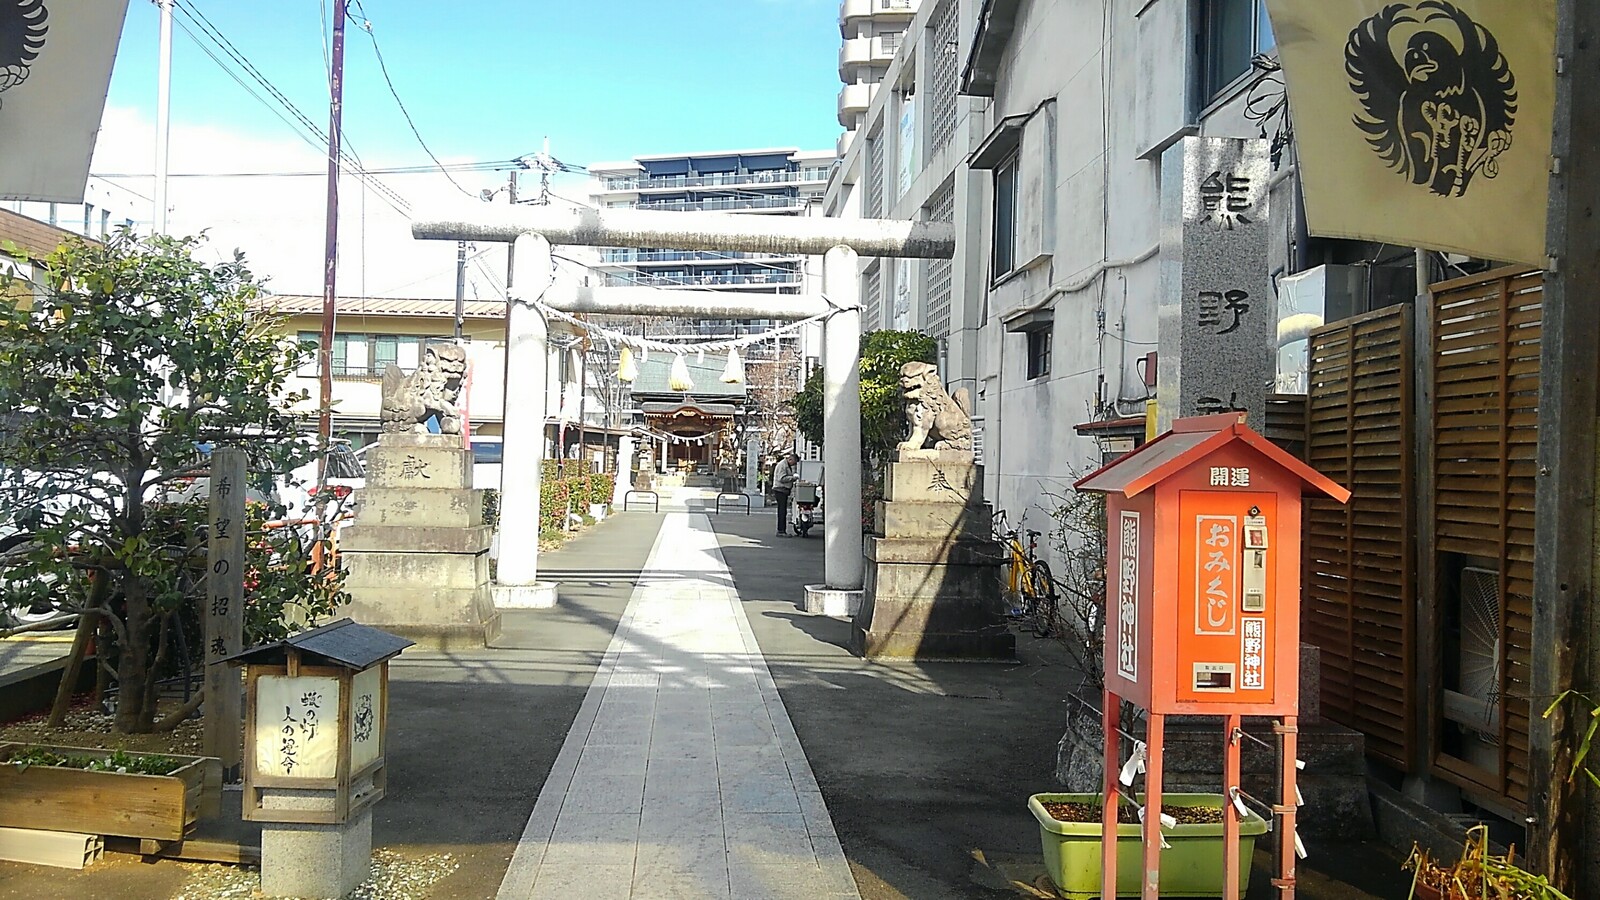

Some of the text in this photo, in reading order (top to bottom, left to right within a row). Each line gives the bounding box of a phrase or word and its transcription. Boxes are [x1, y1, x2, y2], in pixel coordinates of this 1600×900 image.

[927, 470, 953, 494] 奉
[1210, 467, 1250, 487] 開運
[211, 476, 231, 656] 希望の招魂
[1121, 519, 1136, 672] 熊野神社
[1204, 523, 1230, 627] おみくじ
[1244, 621, 1262, 686] 熊野神社
